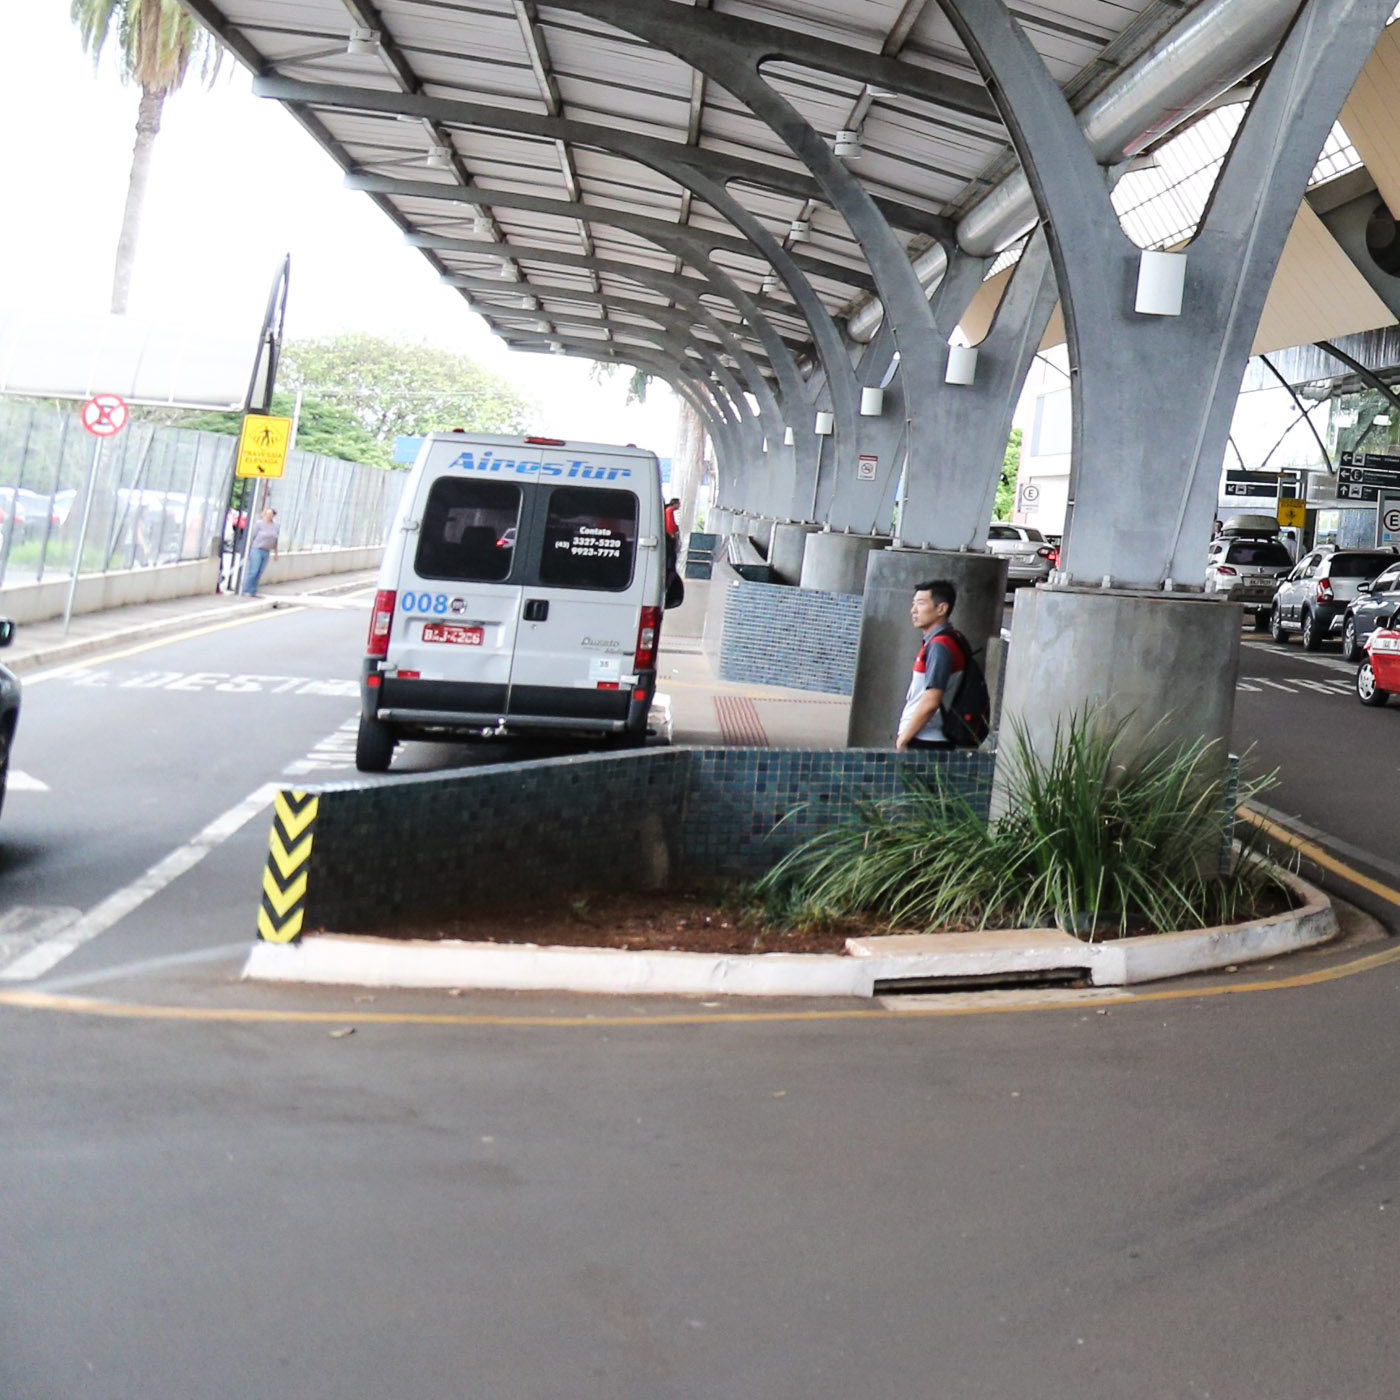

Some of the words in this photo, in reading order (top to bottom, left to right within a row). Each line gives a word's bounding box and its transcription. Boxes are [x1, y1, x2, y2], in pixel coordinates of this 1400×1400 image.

[448, 451, 632, 481] AiresTur
[579, 526, 612, 536] Contato
[555, 540, 569, 549] (43)
[573, 536, 621, 548] 3327-5220
[571, 547, 620, 558] 9923-7774
[401, 592, 449, 614] 008
